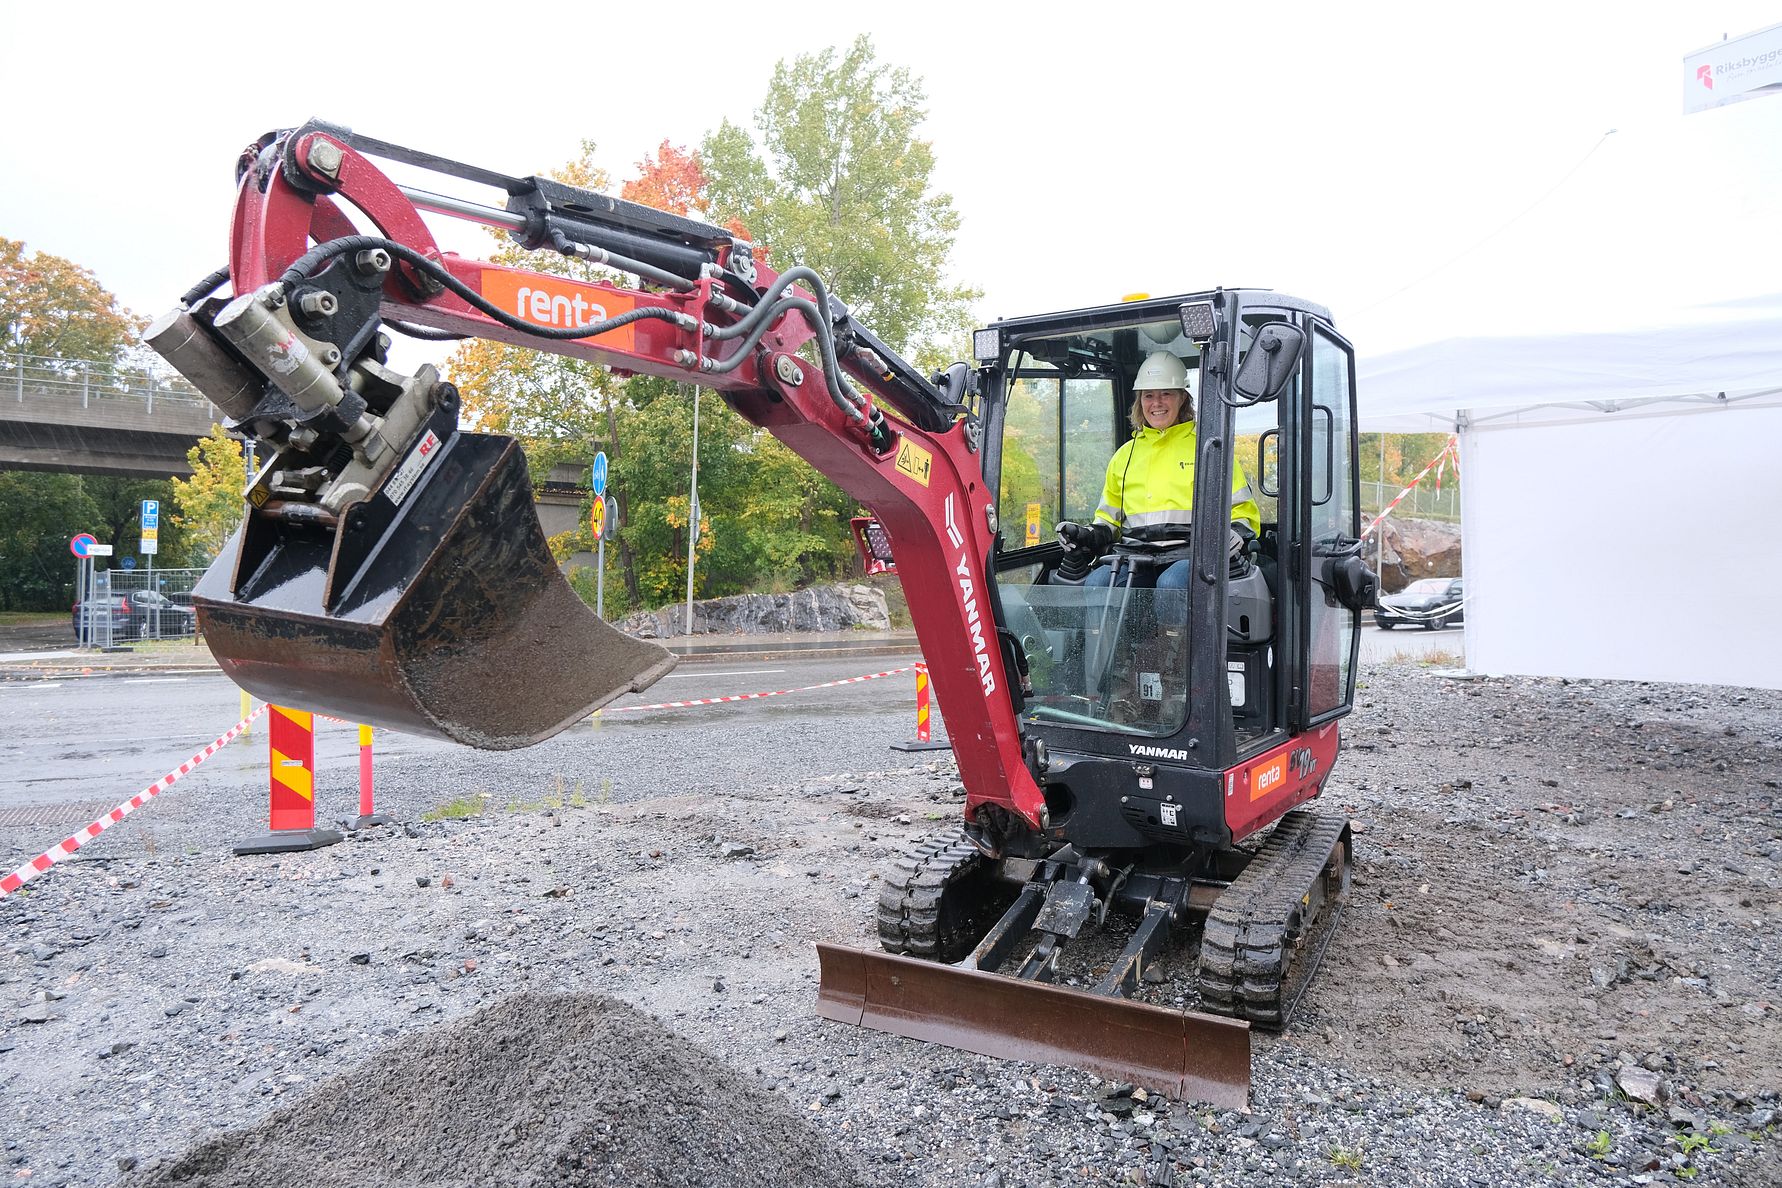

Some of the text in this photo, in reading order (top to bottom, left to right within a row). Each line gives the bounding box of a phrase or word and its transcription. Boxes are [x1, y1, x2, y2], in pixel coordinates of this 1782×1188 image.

[517, 287, 607, 328] renta
[419, 434, 435, 457] RF
[146, 502, 156, 514] P
[593, 507, 603, 528] 40
[956, 552, 996, 697] YANMAR
[1143, 684, 1153, 697] 91
[1128, 744, 1188, 760] YANMAR
[1258, 765, 1280, 790] renta
